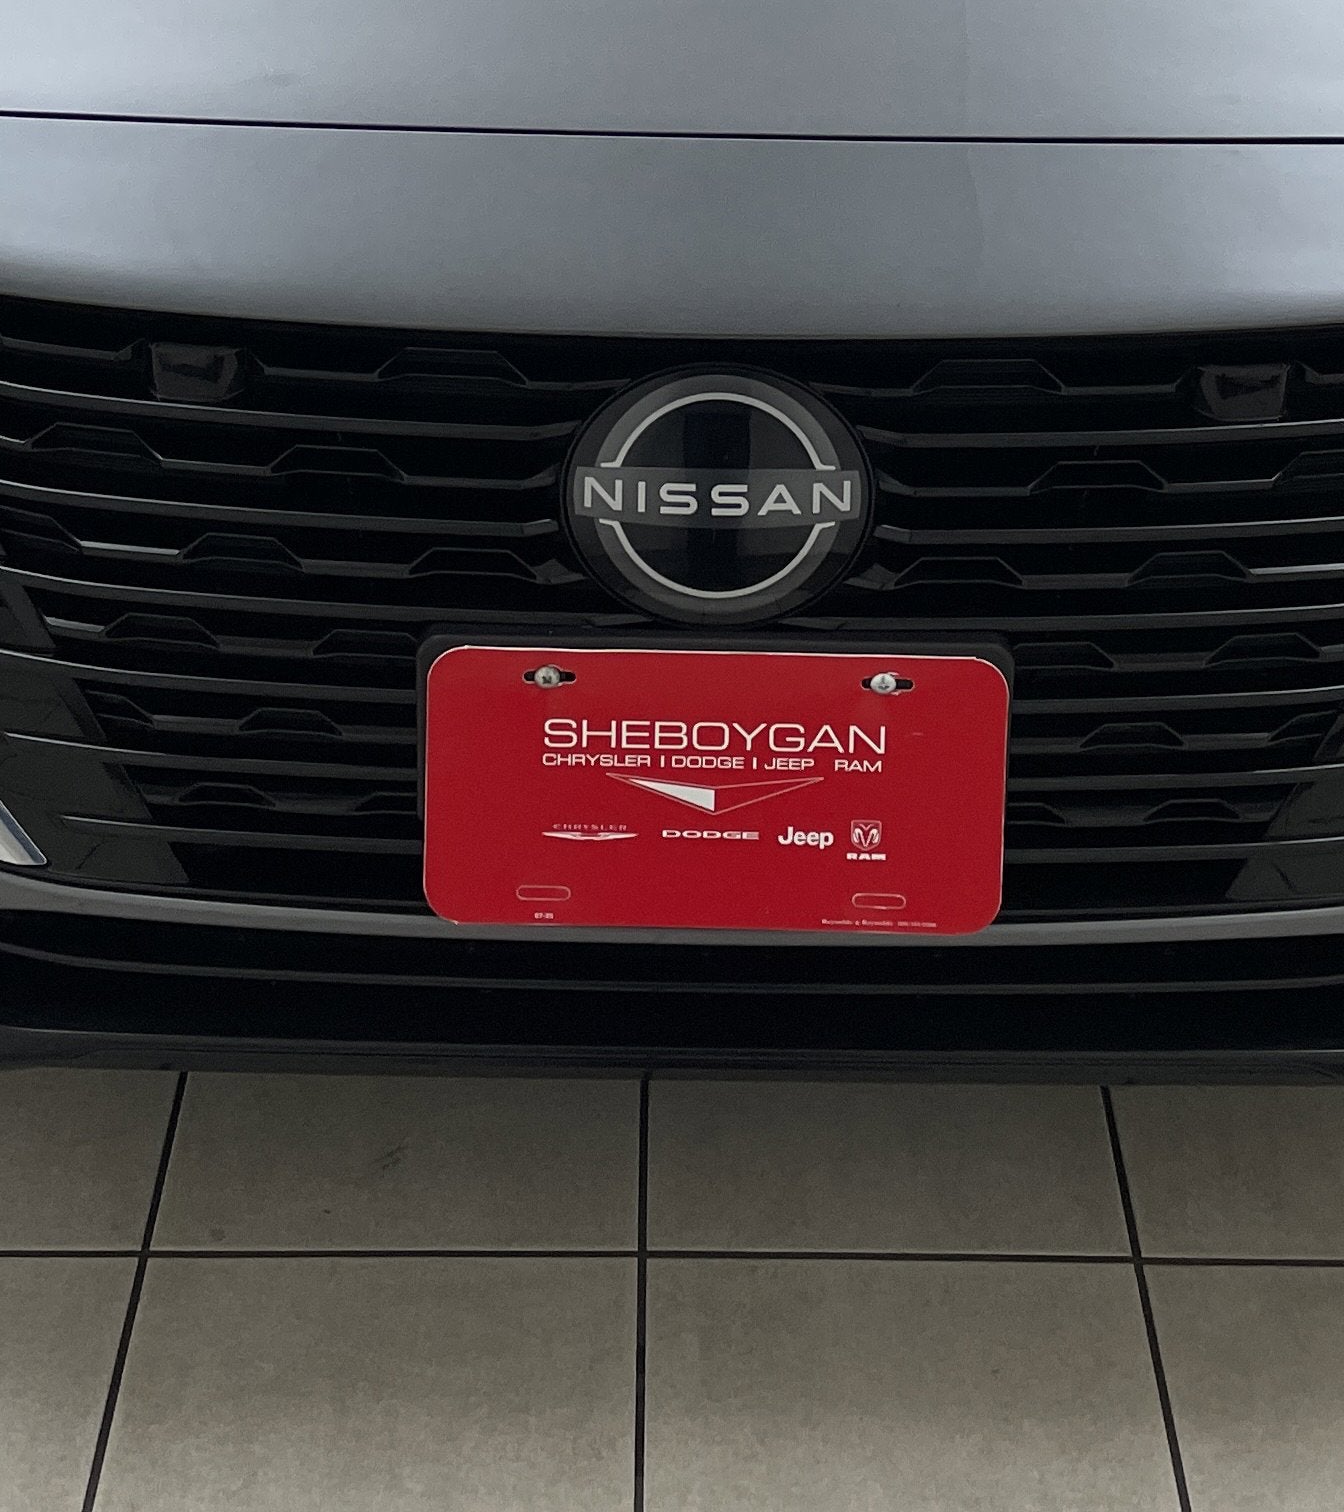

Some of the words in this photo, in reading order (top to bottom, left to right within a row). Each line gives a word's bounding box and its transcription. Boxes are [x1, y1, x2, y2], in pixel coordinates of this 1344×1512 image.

[583, 476, 851, 517] NISSAN
[543, 718, 886, 755] SHEBOYGAN
[542, 753, 651, 768] CHRYSLER
[671, 755, 745, 770] DODGE
[764, 757, 815, 771] JEEP
[834, 759, 883, 773] RAM
[662, 829, 760, 840] DODGE
[777, 826, 834, 849] Jeep
[846, 852, 887, 861] RAM
